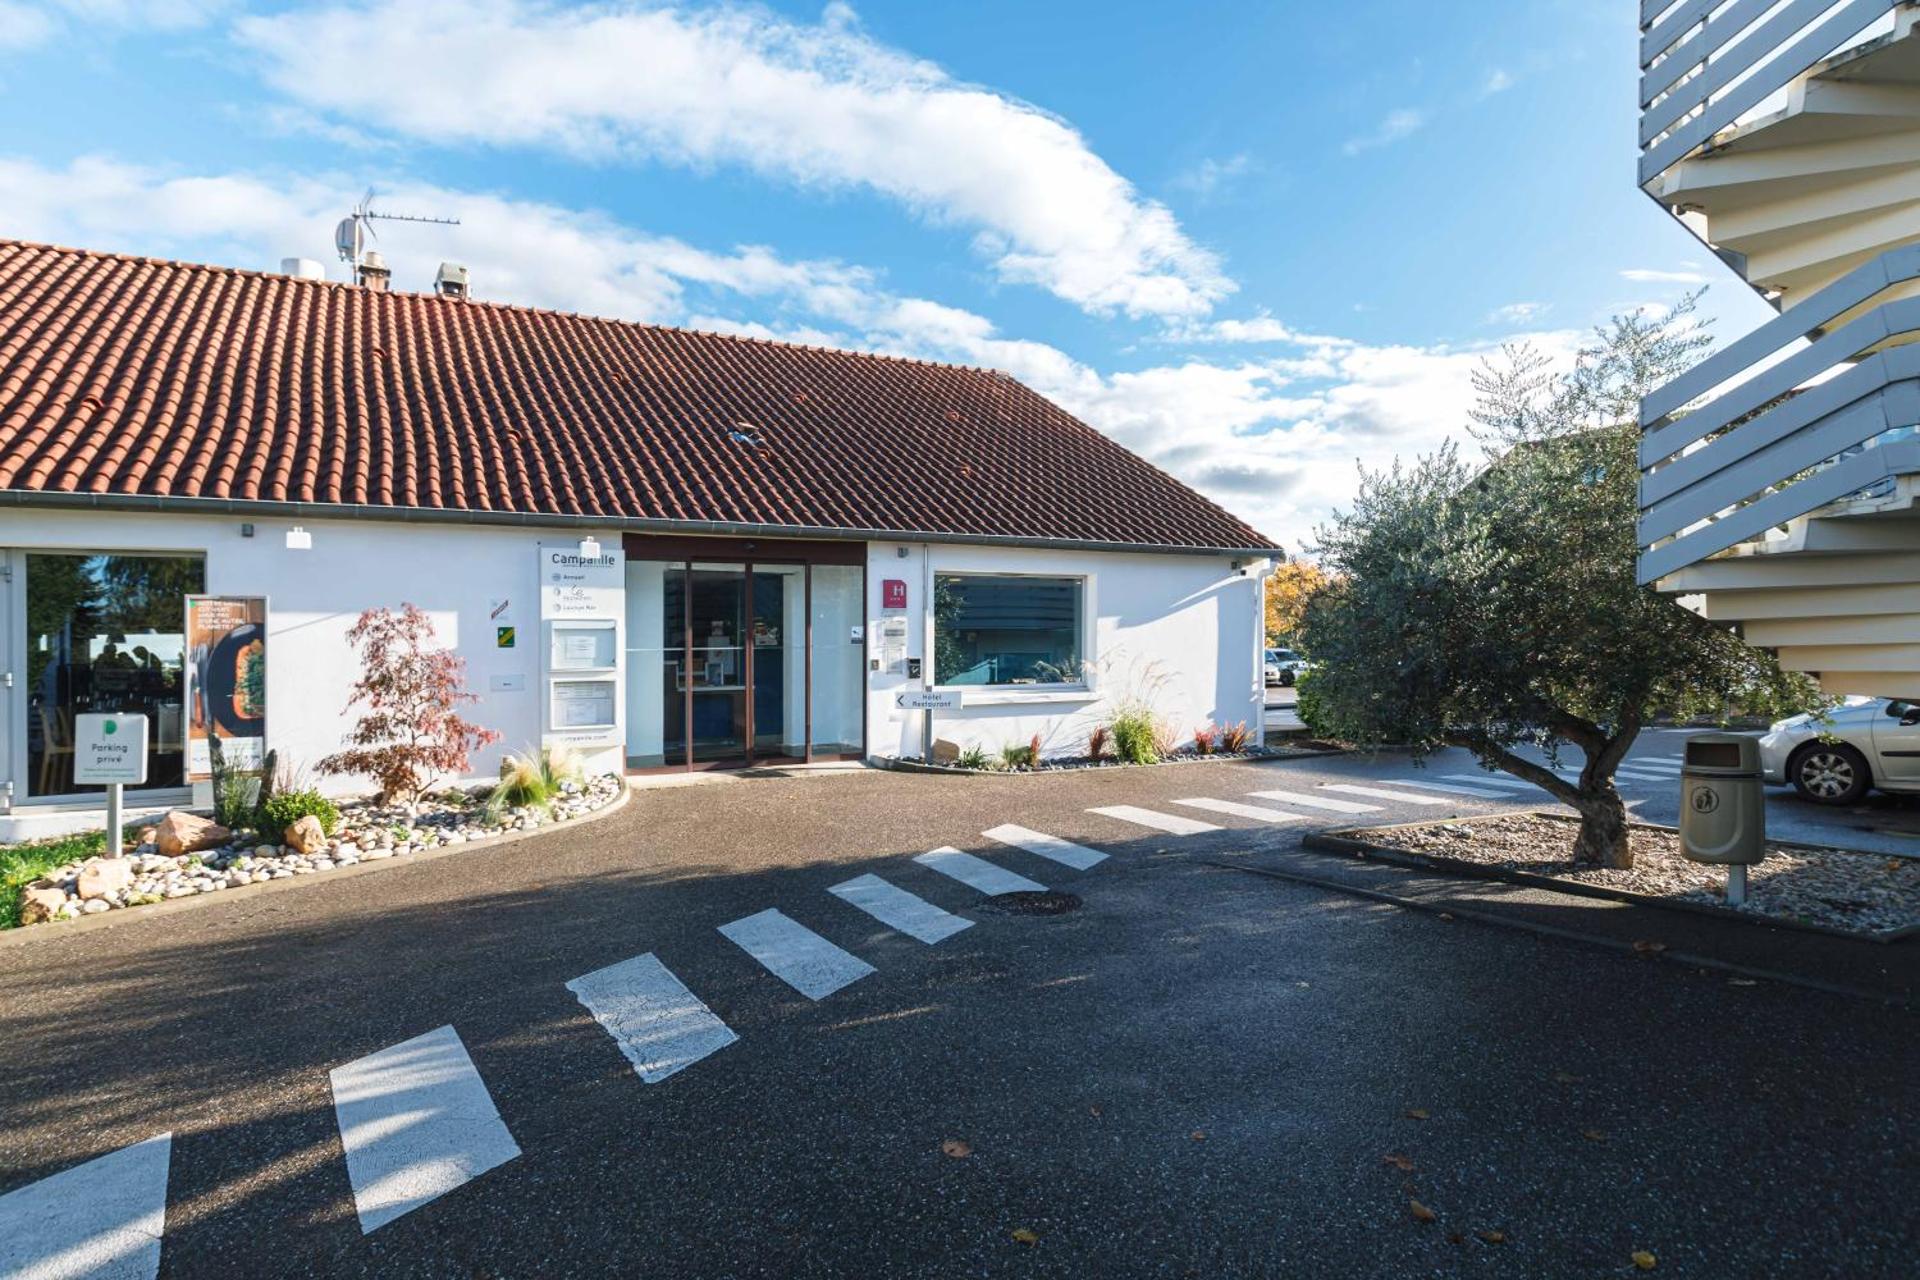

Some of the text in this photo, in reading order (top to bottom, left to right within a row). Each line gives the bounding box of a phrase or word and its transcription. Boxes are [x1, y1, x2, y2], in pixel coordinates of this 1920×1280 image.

[552, 553, 615, 568] Campanile
[92, 744, 128, 753] Parking
[97, 756, 122, 764] privé
